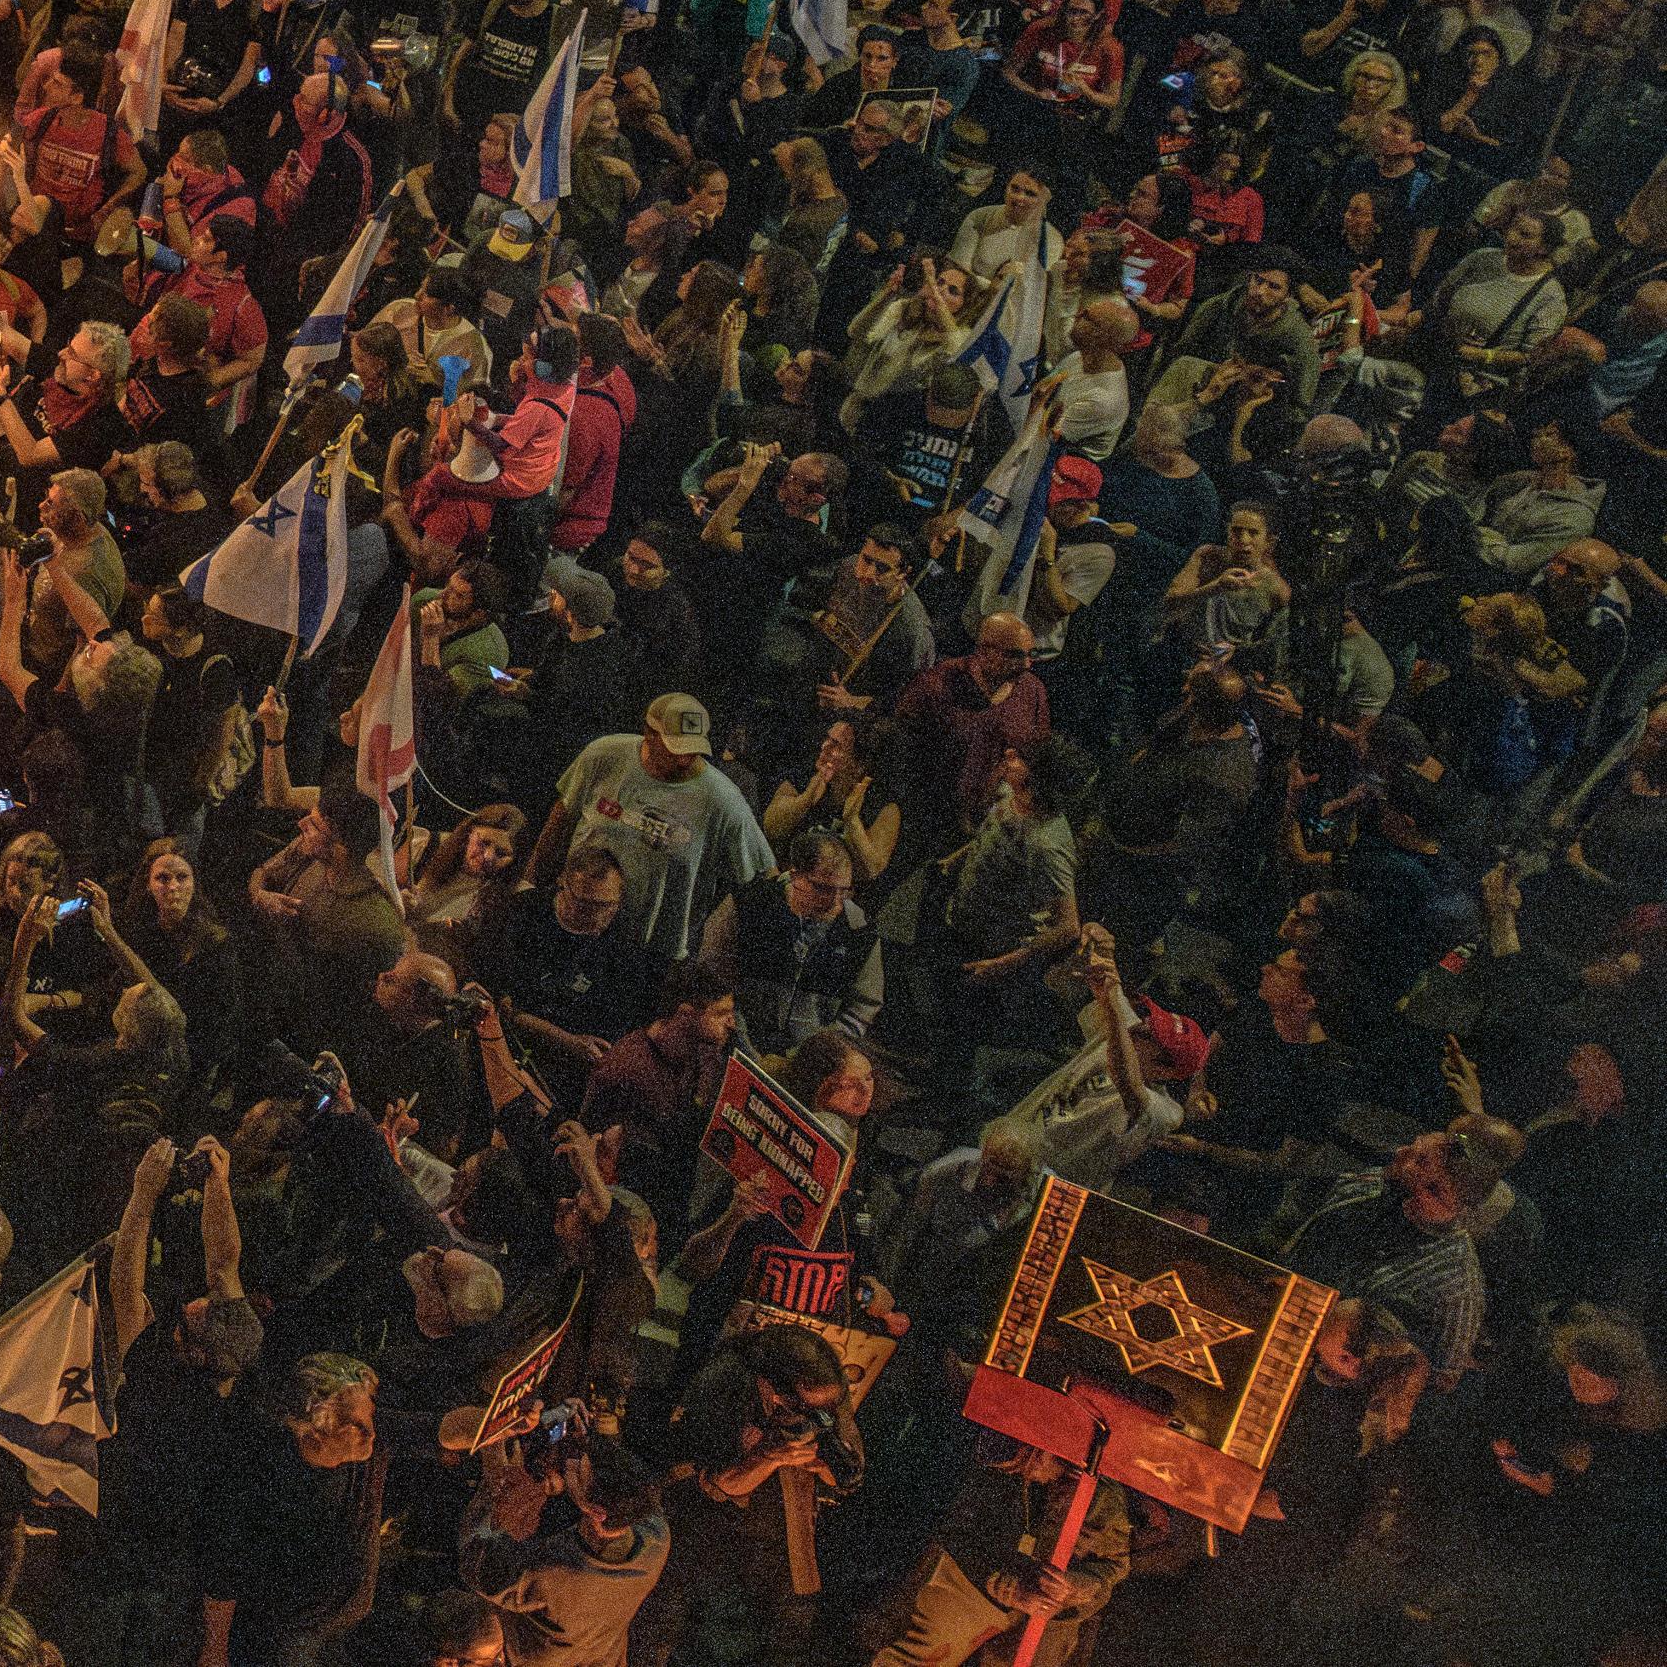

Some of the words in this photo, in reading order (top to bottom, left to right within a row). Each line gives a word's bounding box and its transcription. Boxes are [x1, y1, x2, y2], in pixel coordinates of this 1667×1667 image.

[720, 1101, 759, 1147] BEING
[758, 1133, 826, 1200] KIDNAPPED
[748, 1093, 788, 1141] SORRY
[788, 1127, 815, 1161] FOR
